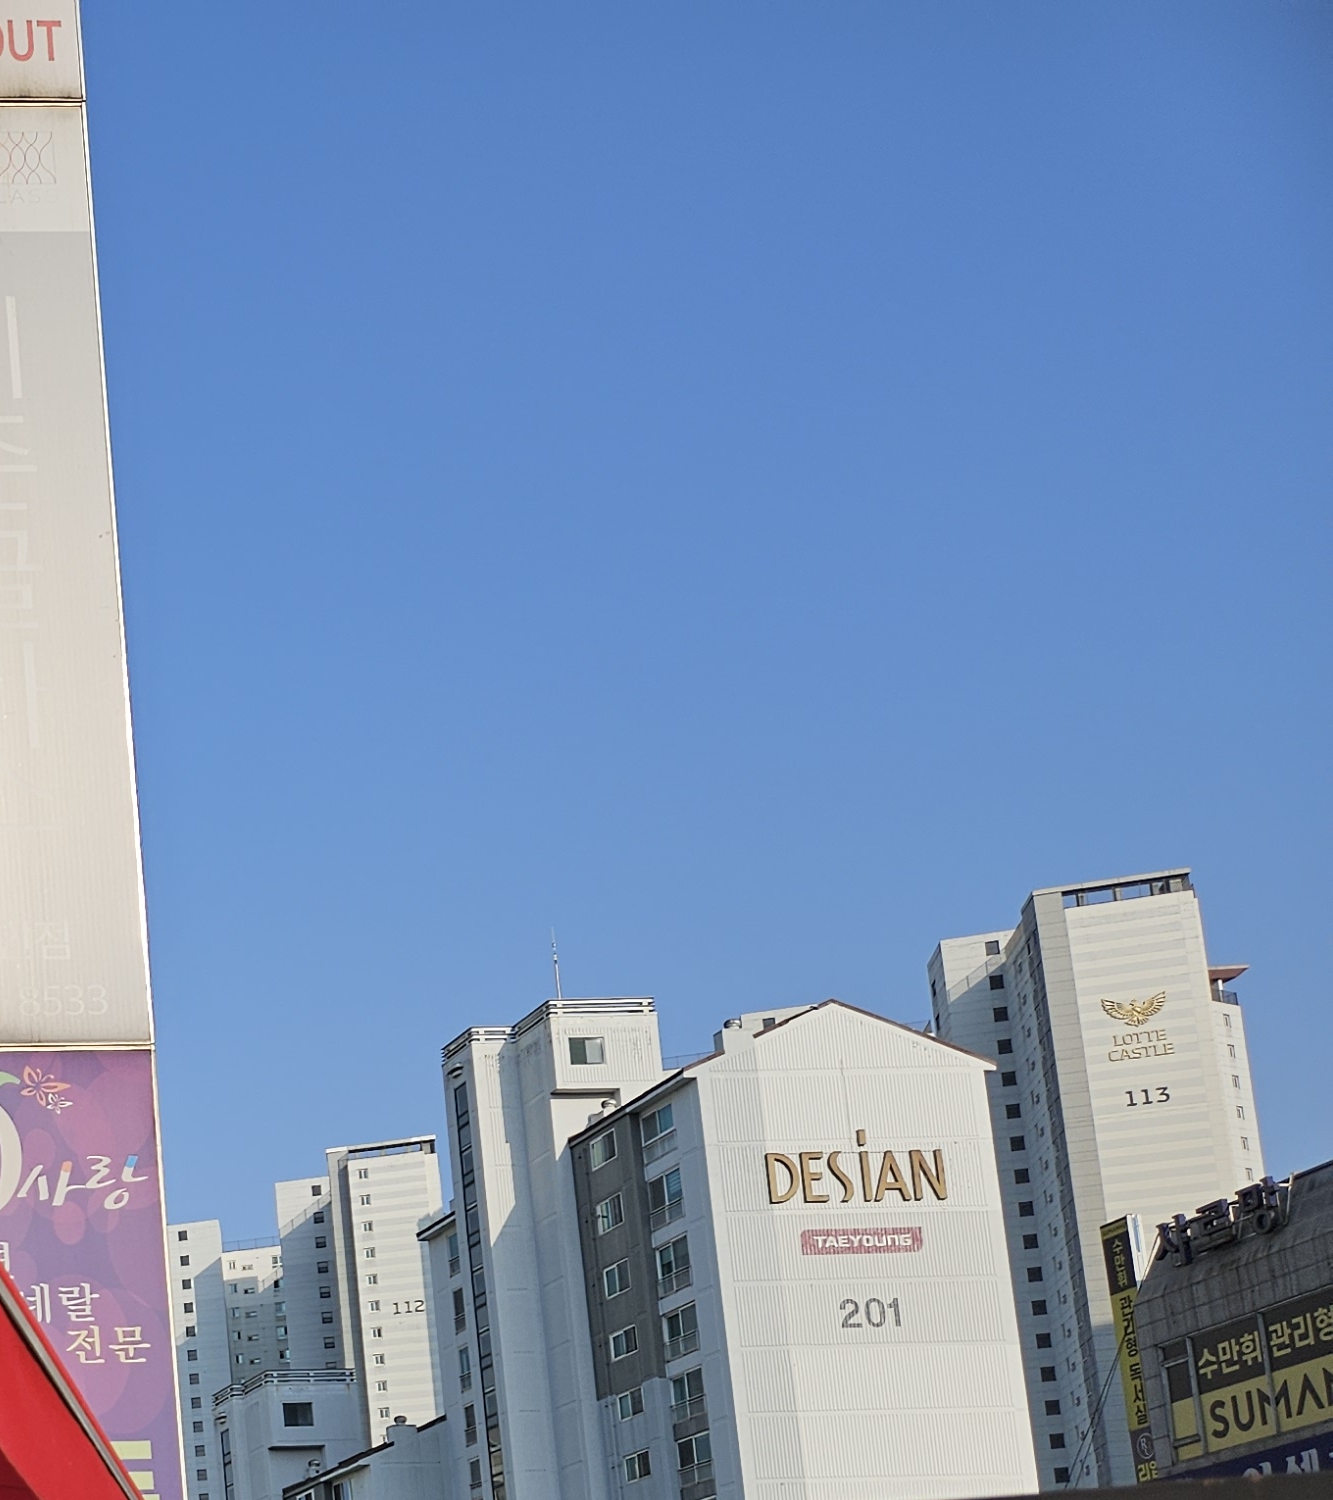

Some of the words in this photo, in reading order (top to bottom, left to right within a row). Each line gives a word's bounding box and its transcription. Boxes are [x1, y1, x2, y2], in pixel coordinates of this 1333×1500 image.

[1113, 1029, 1167, 1046] LOTTE
[1108, 1043, 1175, 1062] CASTLE
[1125, 1086, 1170, 1107] 113
[392, 1300, 426, 1315] 112
[839, 1297, 902, 1329] 201
[66, 1325, 151, 1364] 전문
[1198, 1331, 1262, 1380] 수만휘
[1129, 1363, 1149, 1427] 독서실
